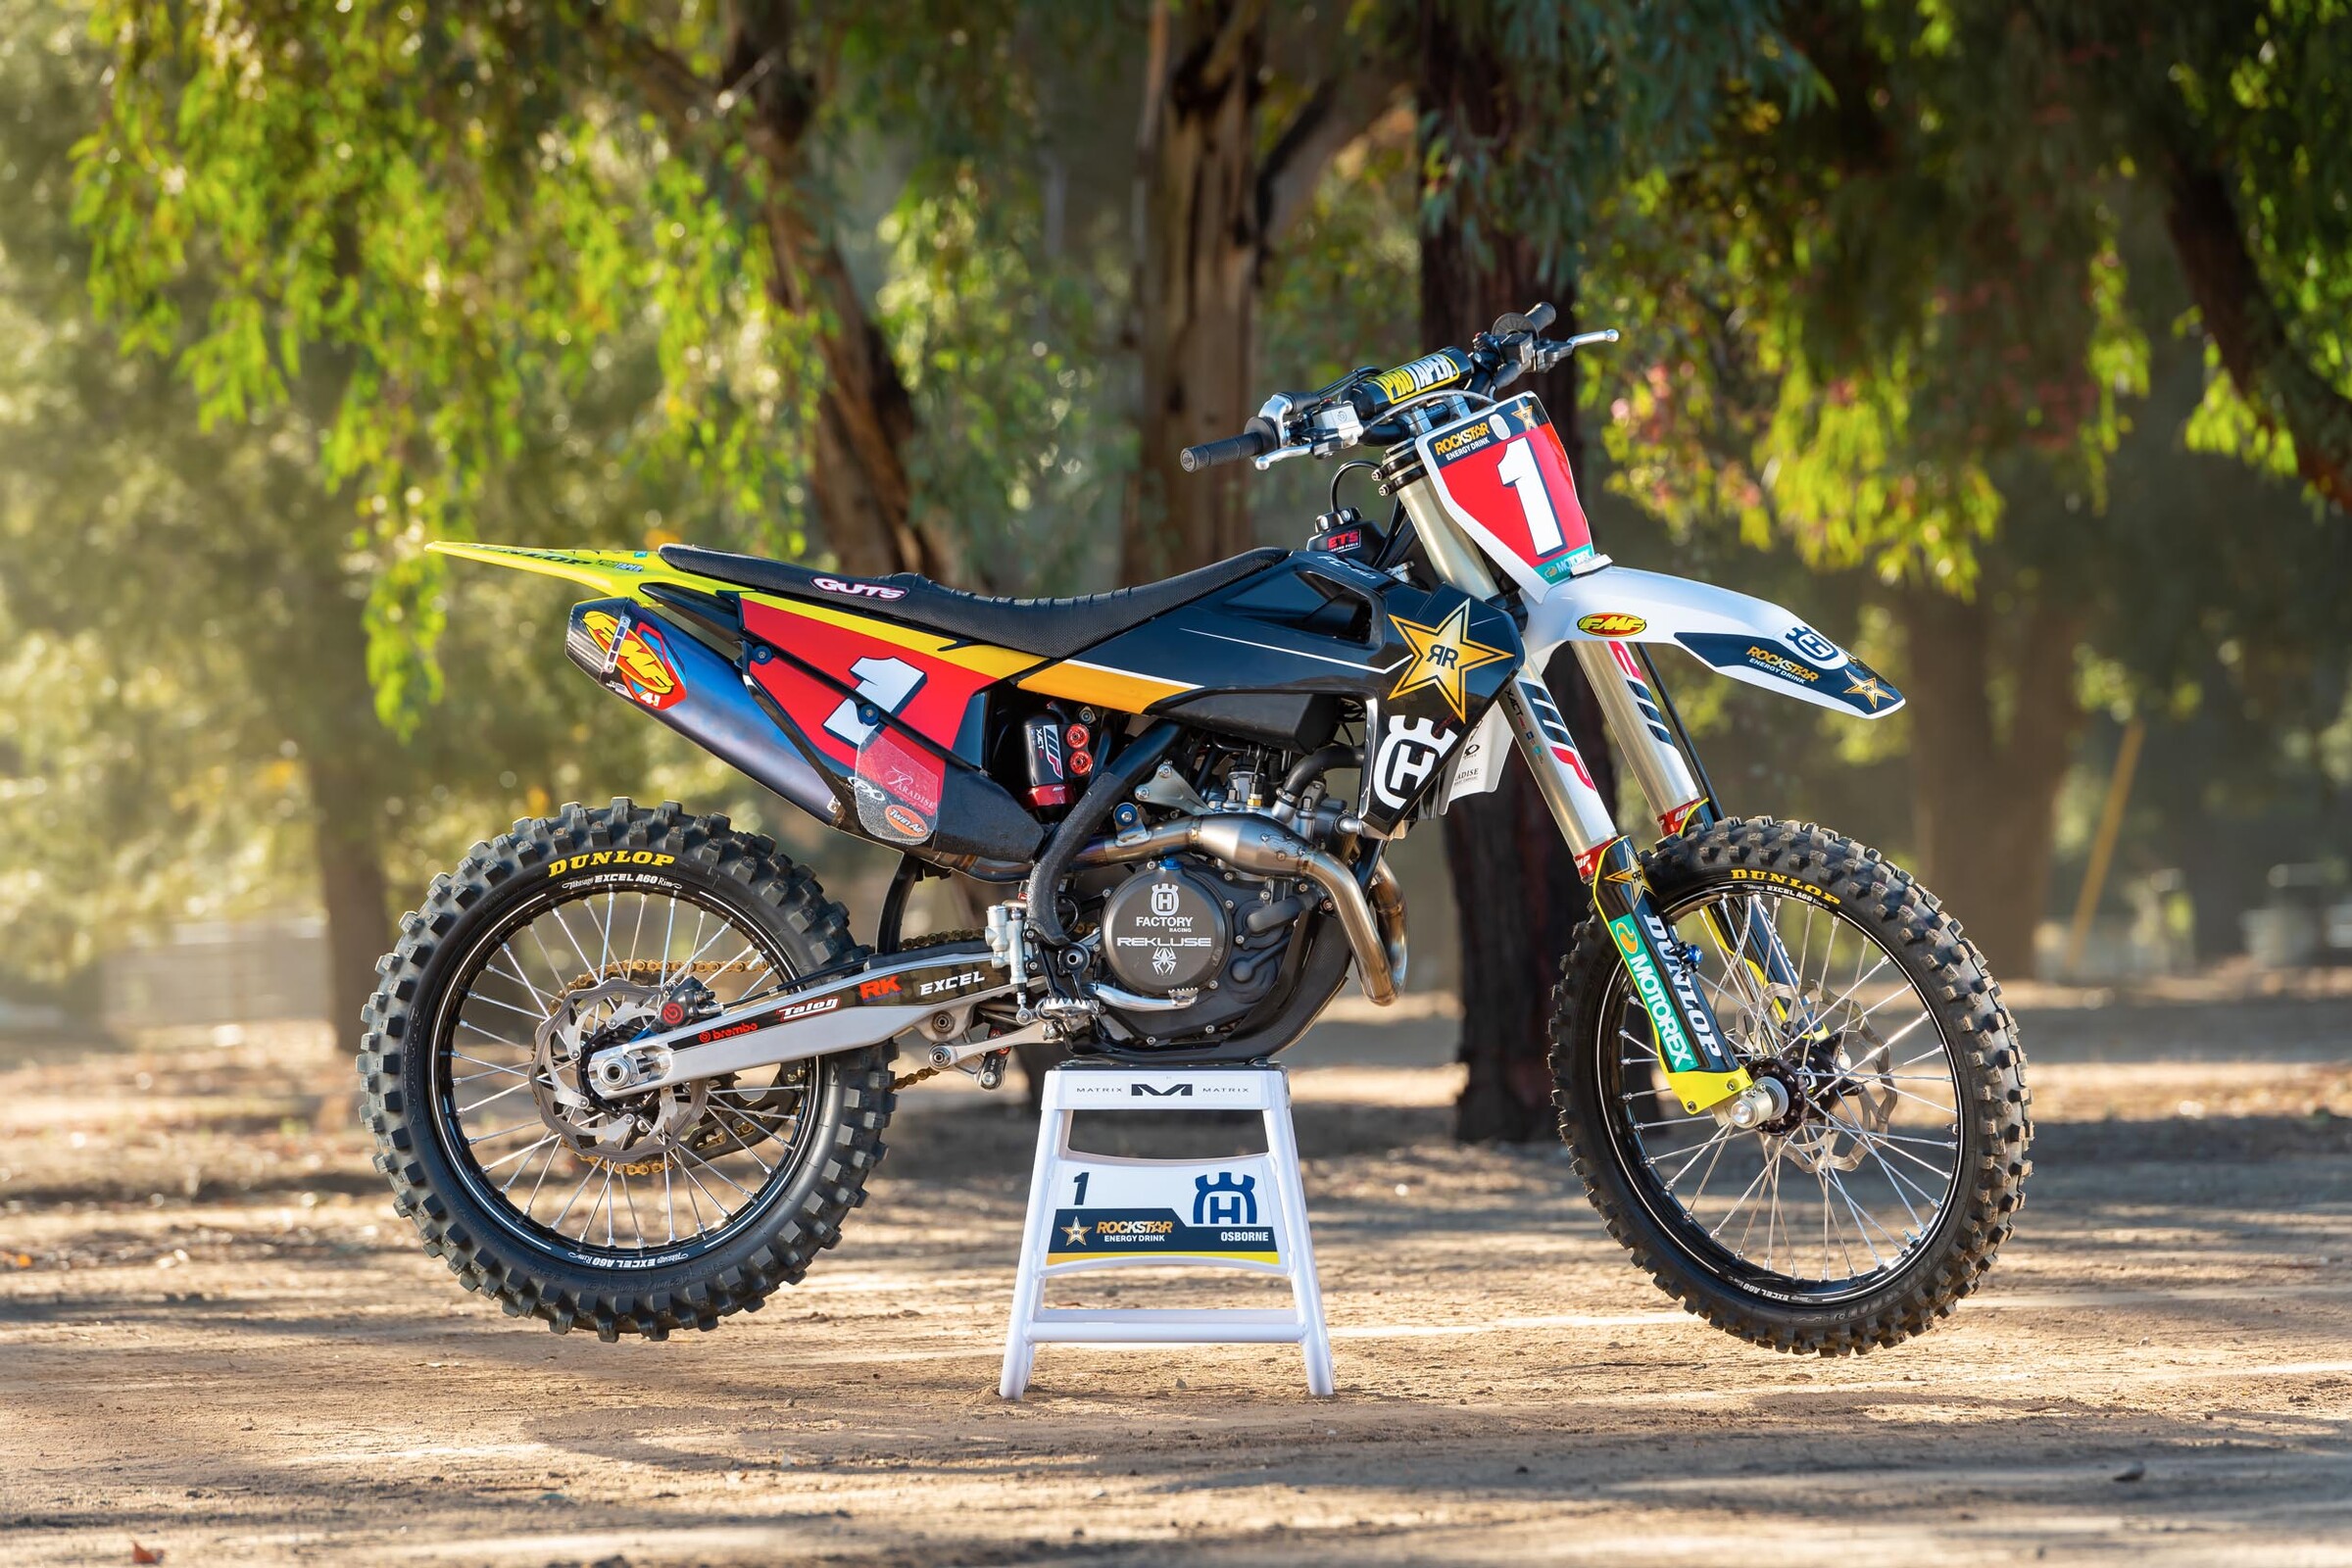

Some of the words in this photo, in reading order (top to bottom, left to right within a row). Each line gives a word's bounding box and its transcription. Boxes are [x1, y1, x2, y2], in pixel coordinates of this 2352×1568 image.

[1434, 422, 1490, 456] ROCKSTAR
[1446, 446, 1471, 461] ENERGY
[1470, 437, 1490, 450] DRINK
[1497, 437, 1565, 557] 1
[1327, 530, 1358, 549] ETS
[812, 577, 905, 599] GUTS
[1579, 614, 1646, 635] FMF
[1746, 646, 1820, 683] ROCKSTAR
[1748, 658, 1780, 675] ENERGY
[1780, 668, 1807, 684] DRINK
[823, 657, 927, 747] 1
[1505, 689, 1524, 716] XACT
[548, 850, 675, 878] DUNLOP
[594, 873, 634, 883] EXCEL
[635, 873, 659, 884] A60
[1731, 868, 1840, 906] DUNLOP
[1766, 885, 1795, 897] EXCEL
[1136, 916, 1194, 927] FACTORY
[1116, 937, 1212, 947] REKLUSE
[858, 975, 901, 999] RK
[919, 971, 985, 997] EXCEL
[1642, 913, 1722, 1057] DUNLOP
[778, 997, 840, 1020] Talon
[1629, 955, 1693, 1068] MOTOREX
[712, 1022, 759, 1041] brembo
[1073, 1172, 1090, 1205] 1
[1096, 1221, 1173, 1234] ROCKSTAR
[1220, 1231, 1269, 1242] OSBORNE
[616, 1257, 656, 1268] EXCEL
